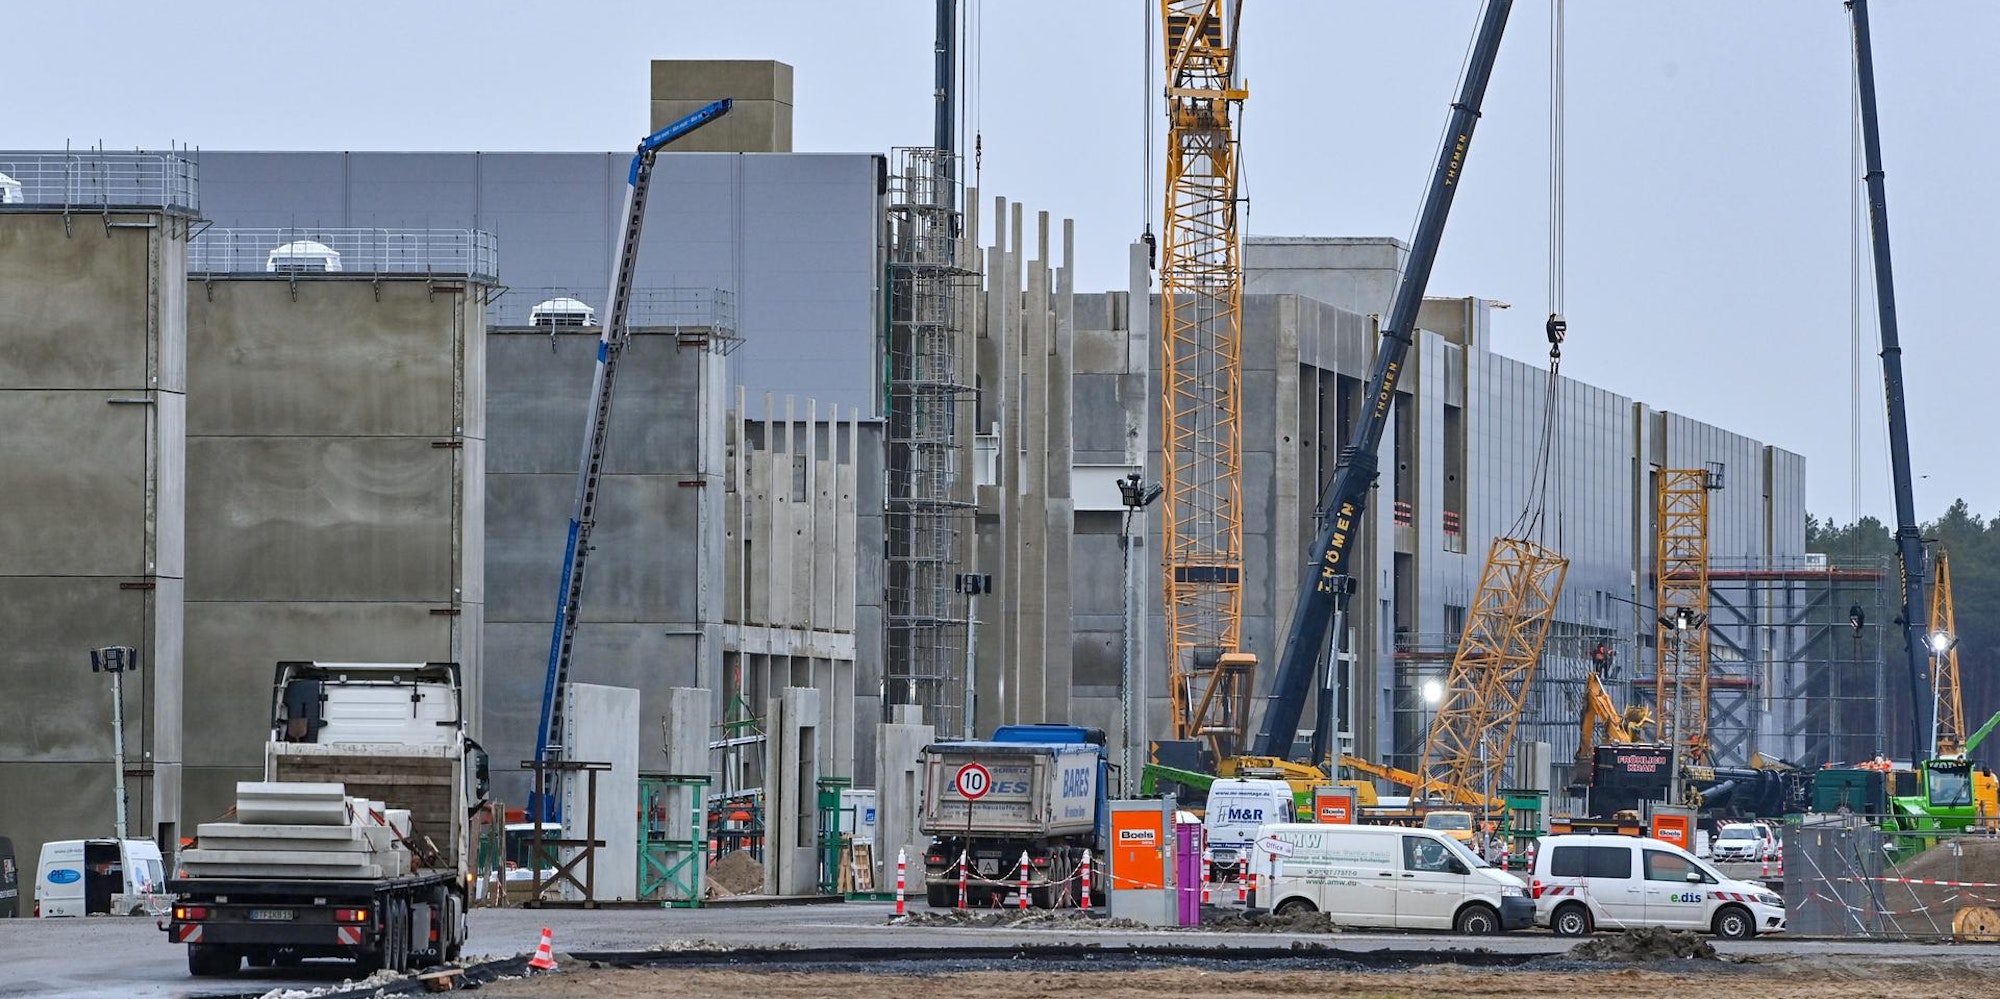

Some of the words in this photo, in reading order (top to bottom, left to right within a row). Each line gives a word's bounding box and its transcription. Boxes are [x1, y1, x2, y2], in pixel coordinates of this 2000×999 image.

[1627, 764, 1656, 772] KRAN
[965, 772, 983, 790] 10
[1063, 767, 1089, 798] BARES
[1228, 808, 1263, 820] M&R
[1121, 831, 1154, 839] Boels
[1266, 841, 1283, 851] Office
[983, 861, 994, 872] A
[1306, 879, 1357, 887] www.amw.eu
[1671, 893, 1702, 903] e.dis
